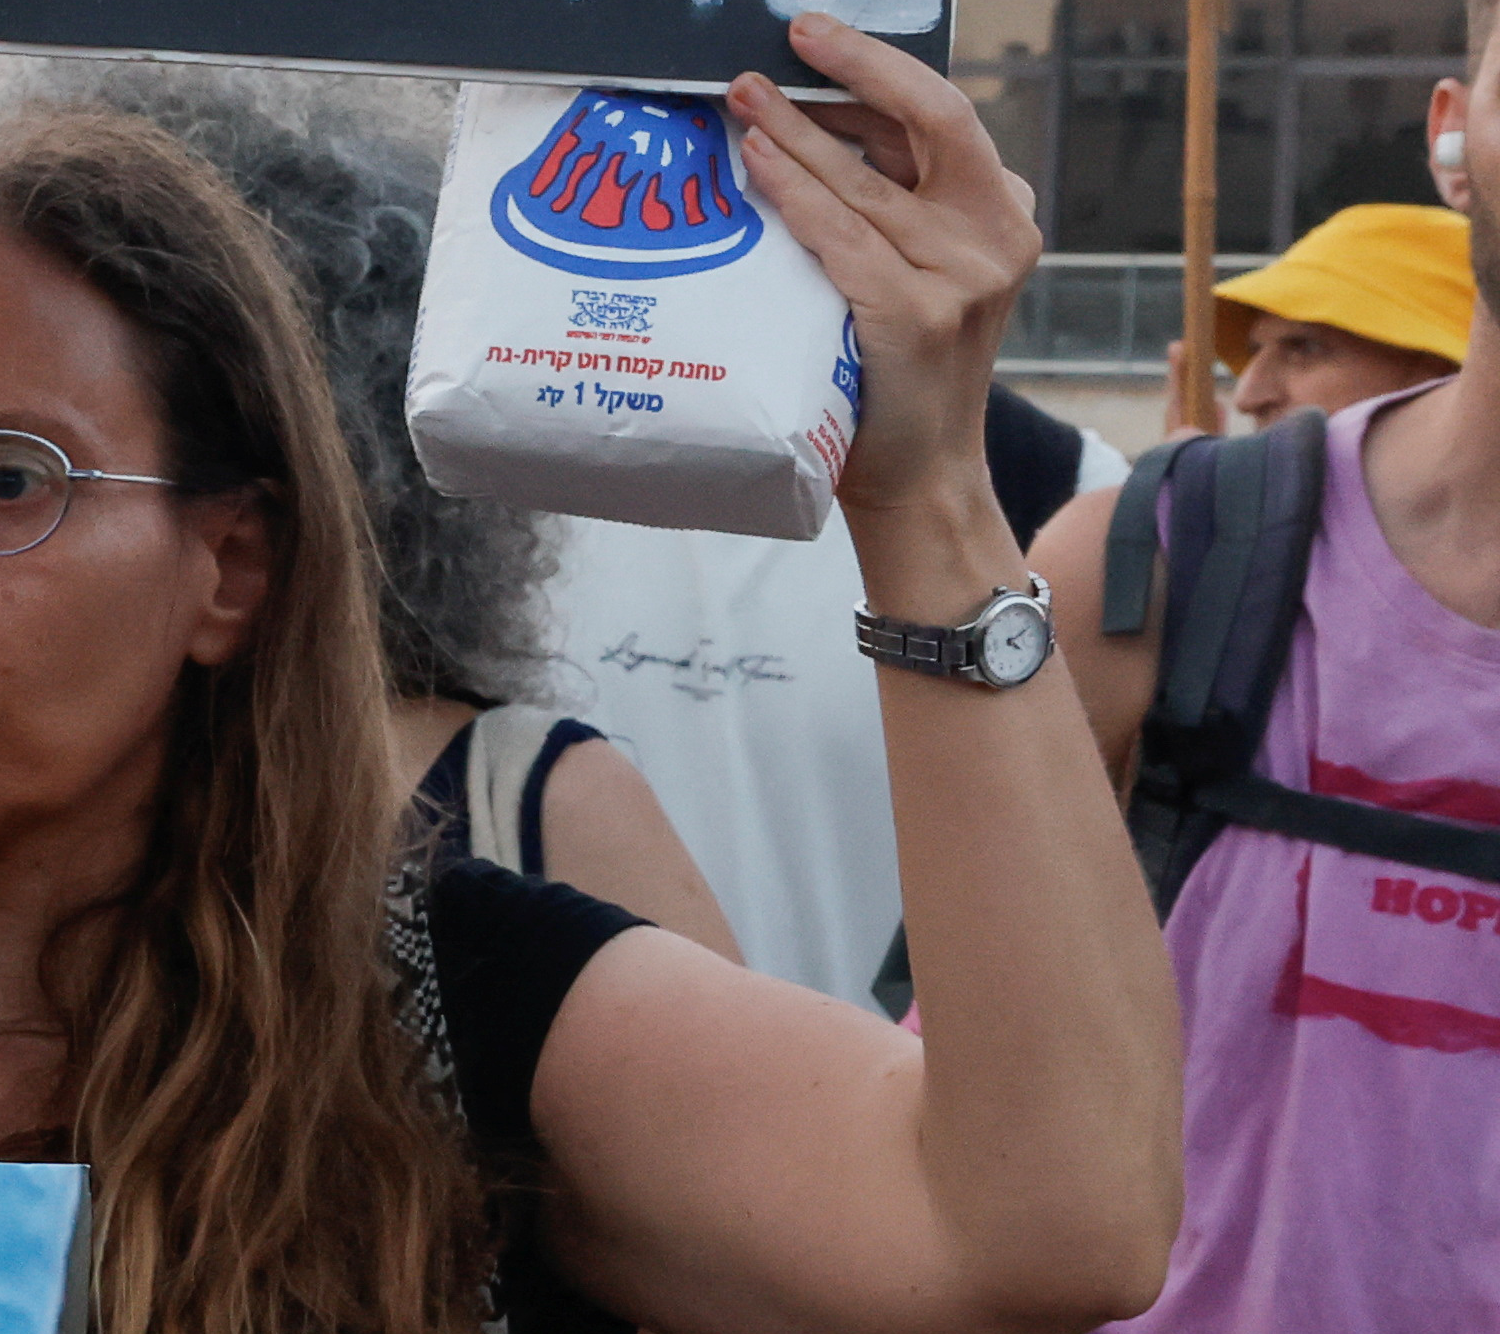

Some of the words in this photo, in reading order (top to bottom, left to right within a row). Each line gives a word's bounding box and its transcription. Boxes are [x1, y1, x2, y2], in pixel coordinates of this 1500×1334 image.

[577, 351, 612, 372] רוט
[616, 354, 665, 380] קמח
[667, 360, 727, 382] טחנת
[573, 380, 585, 406] 1
[593, 381, 664, 415] משקל
[1370, 876, 1500, 937] HOP
